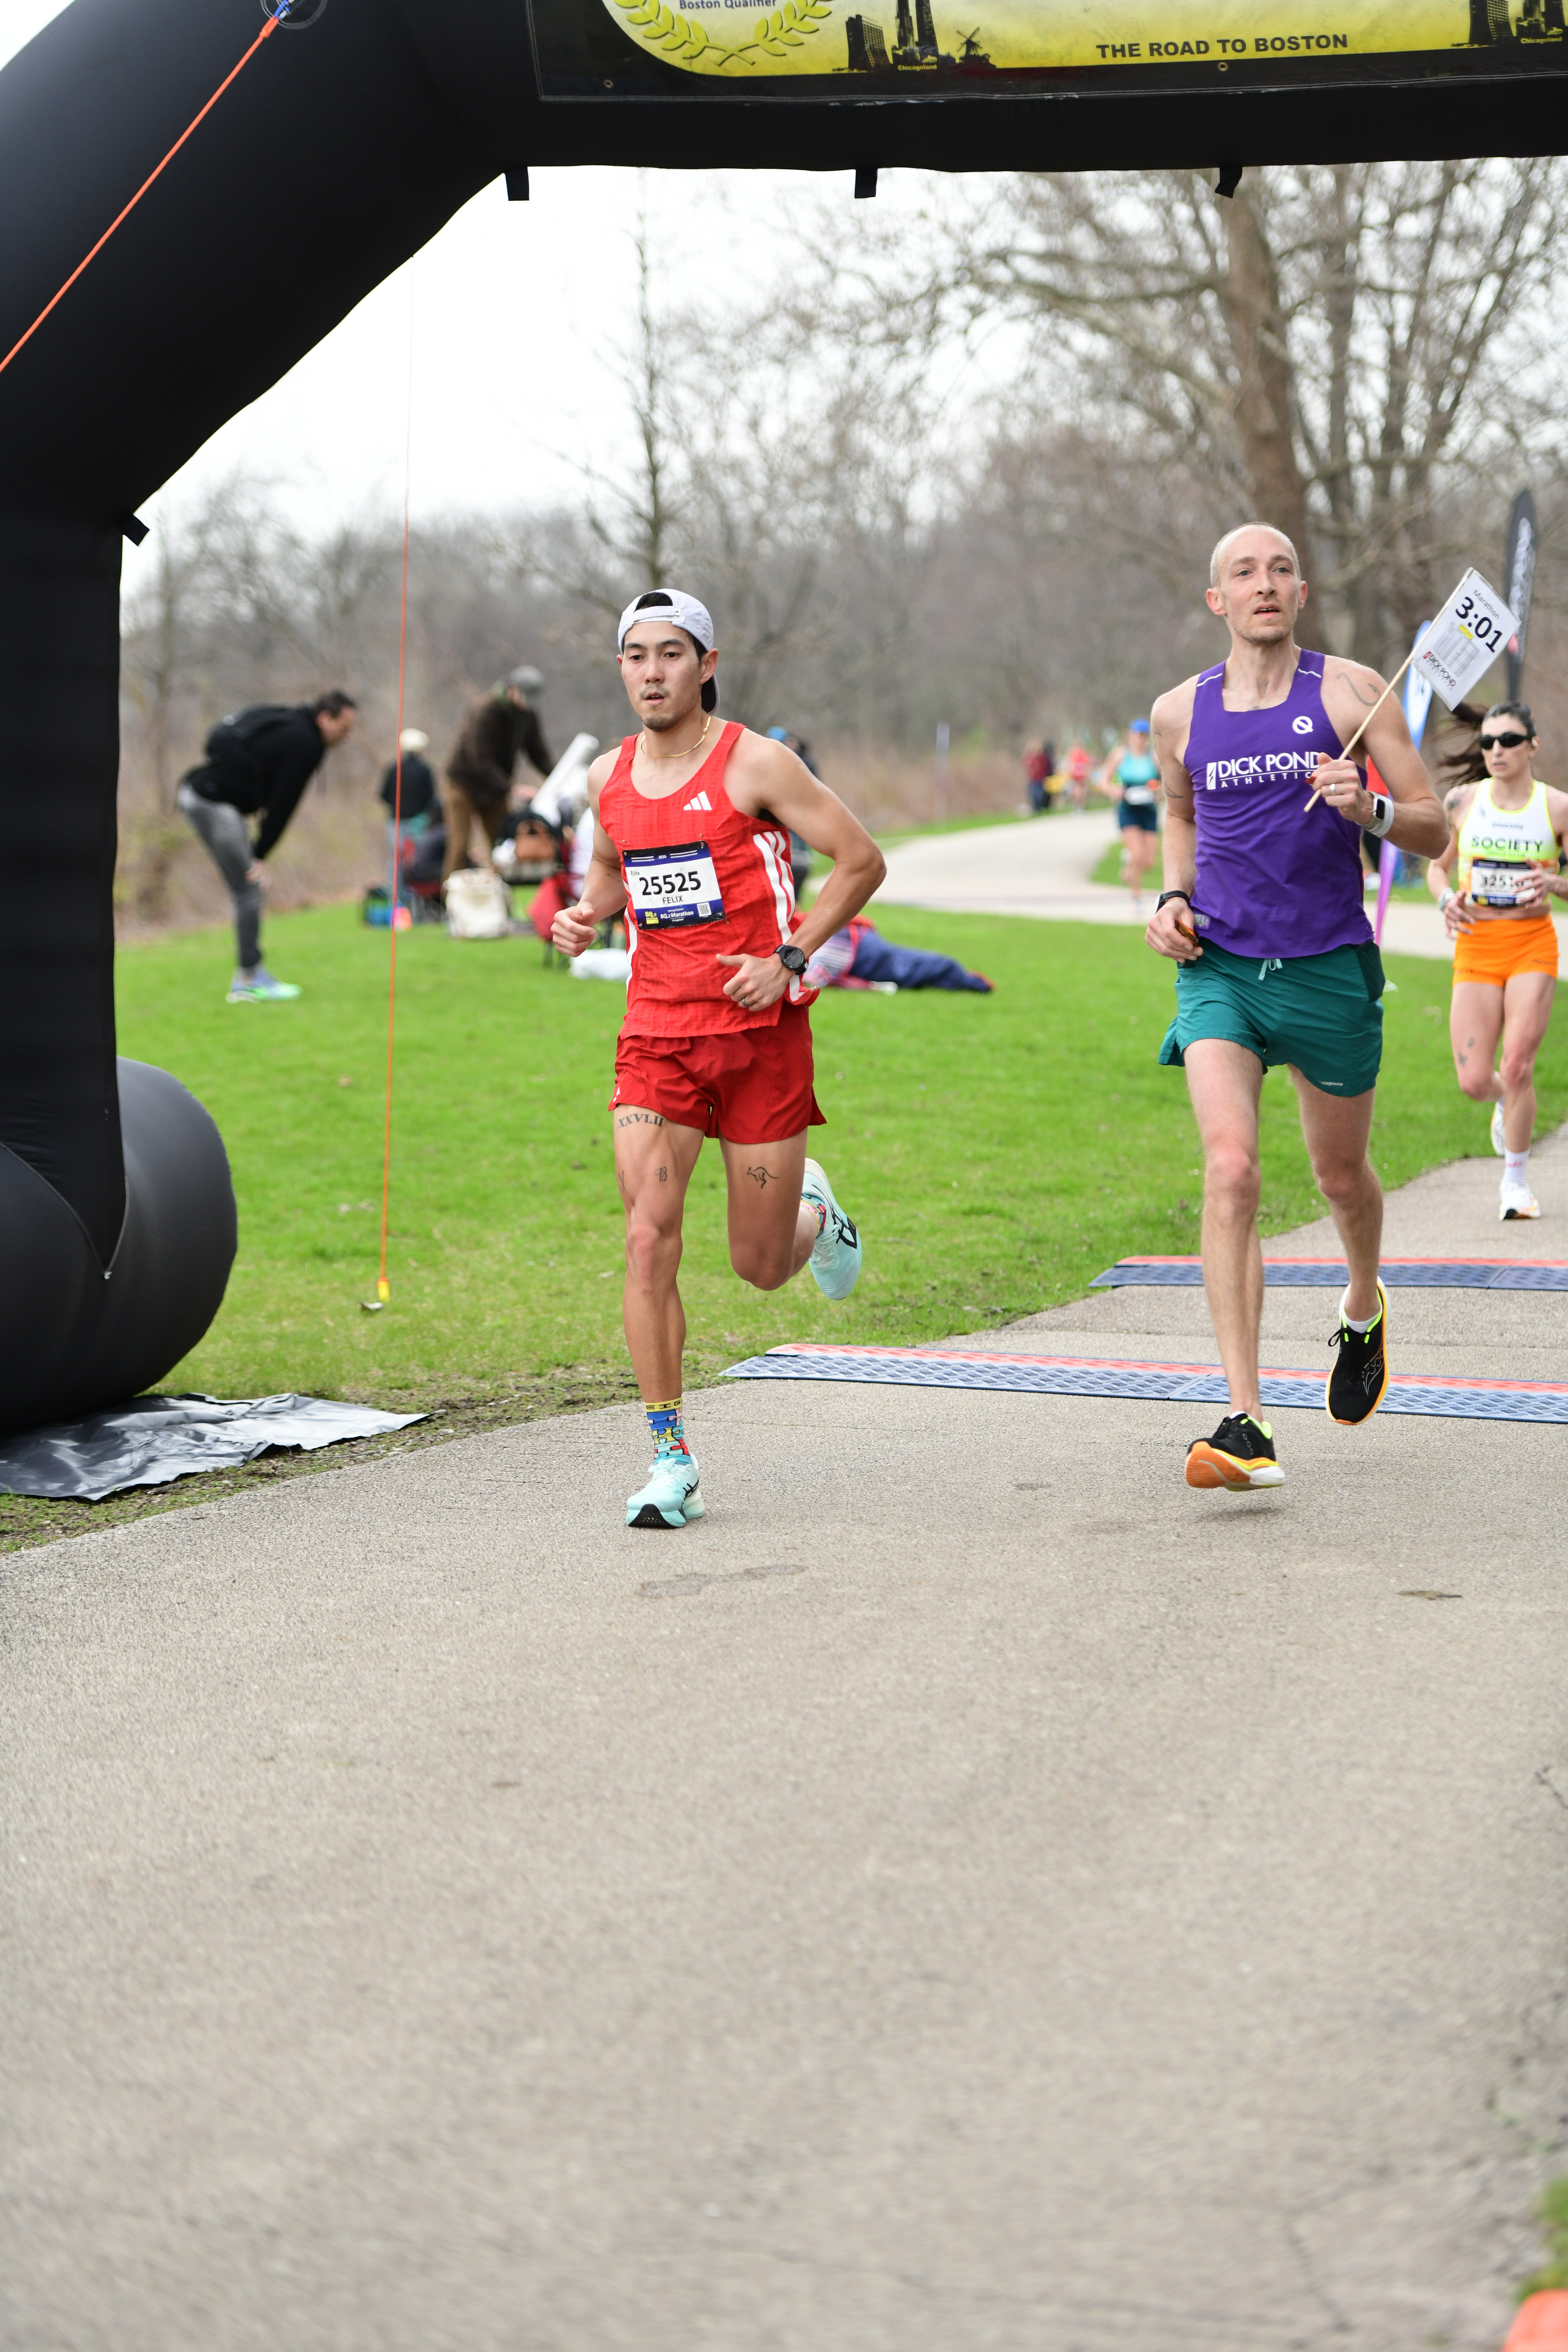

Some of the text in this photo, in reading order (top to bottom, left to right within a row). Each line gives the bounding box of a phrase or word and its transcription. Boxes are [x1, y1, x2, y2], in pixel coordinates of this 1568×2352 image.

[680, 0, 721, 9] Boston
[1096, 34, 1348, 58] THE ROAD TO BOSTON
[1473, 590, 1500, 619] Marathon
[1456, 596, 1503, 653] 3:01
[1429, 654, 1456, 686] DICK POND
[1217, 751, 1320, 778] DICK POND
[1221, 771, 1312, 788] ATHLETIC
[1472, 836, 1544, 851] SOCIETY
[639, 871, 701, 896] 25525
[662, 895, 684, 904] FELIX
